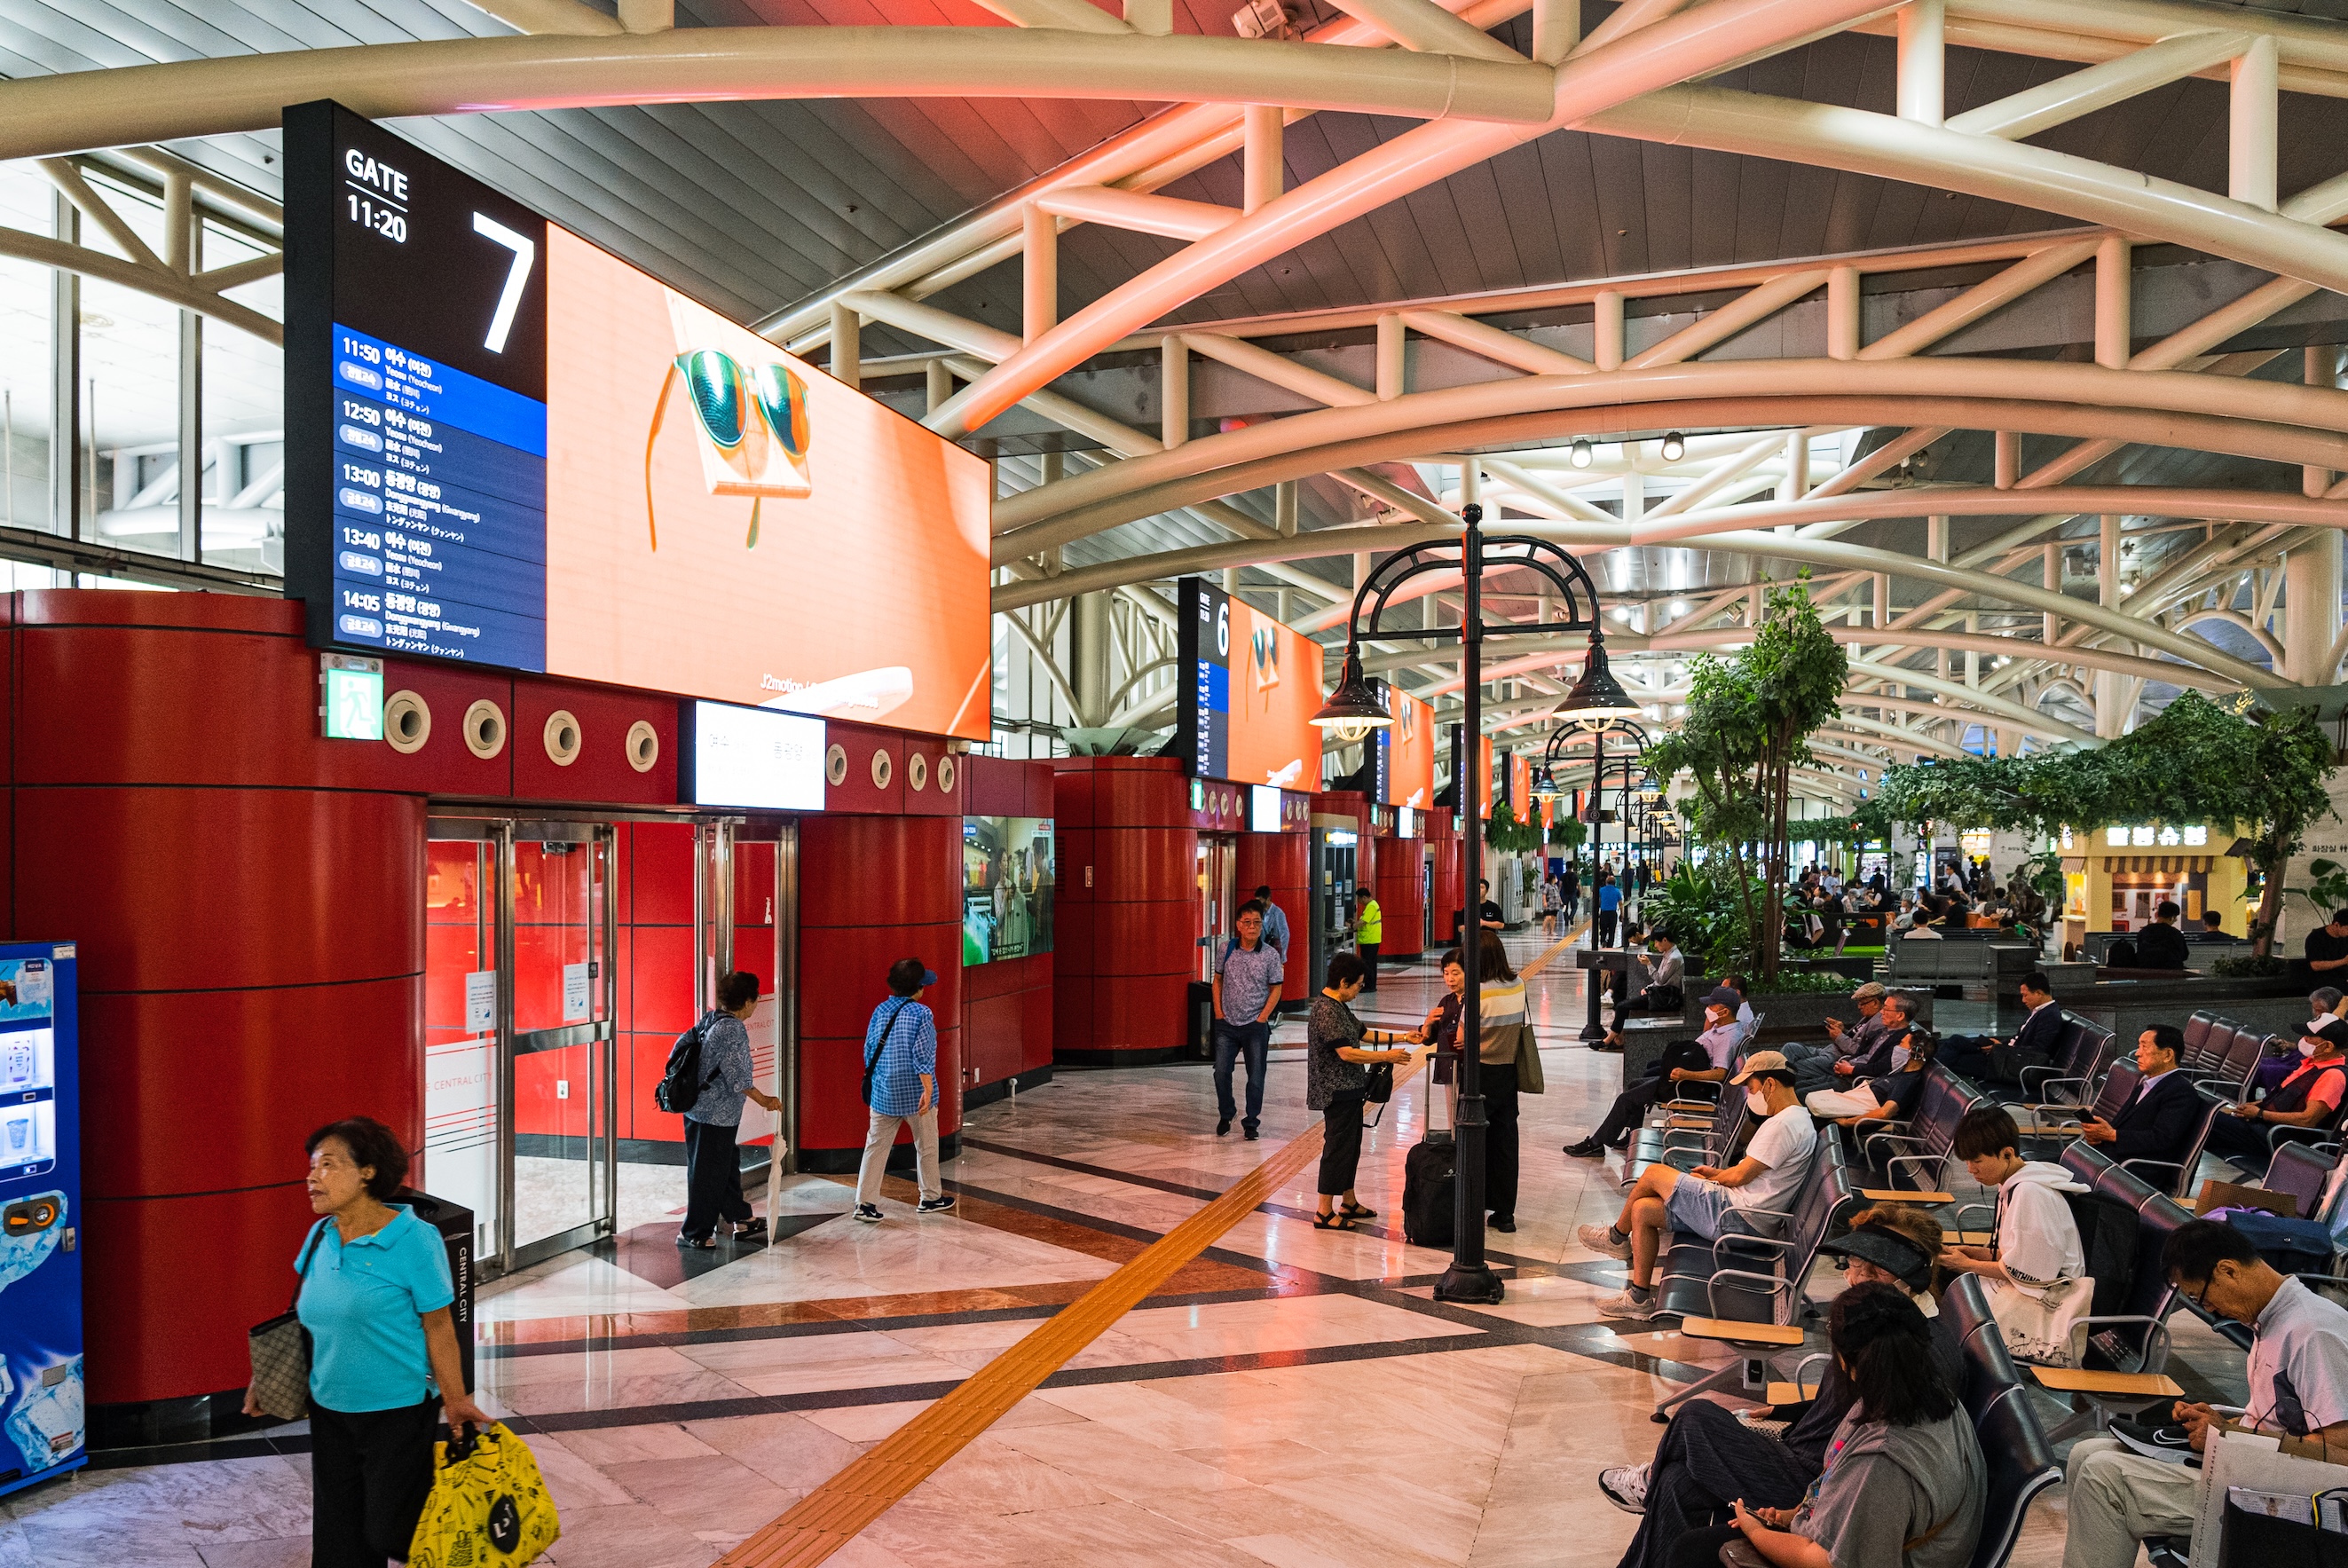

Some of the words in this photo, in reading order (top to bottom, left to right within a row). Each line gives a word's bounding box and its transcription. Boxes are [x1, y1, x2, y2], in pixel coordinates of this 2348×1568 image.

[345, 147, 408, 201] GATE
[348, 193, 408, 244] 11:20
[472, 210, 535, 354] 7
[343, 337, 380, 364] 11:50
[343, 400, 380, 426] 12:50
[343, 464, 380, 488] 13:00
[343, 527, 380, 550] 13:40
[343, 590, 380, 611] 14:05
[1217, 602, 1229, 657] 6
[434, 1076, 472, 1091] CENTRAL
[474, 1072, 492, 1083] CITY
